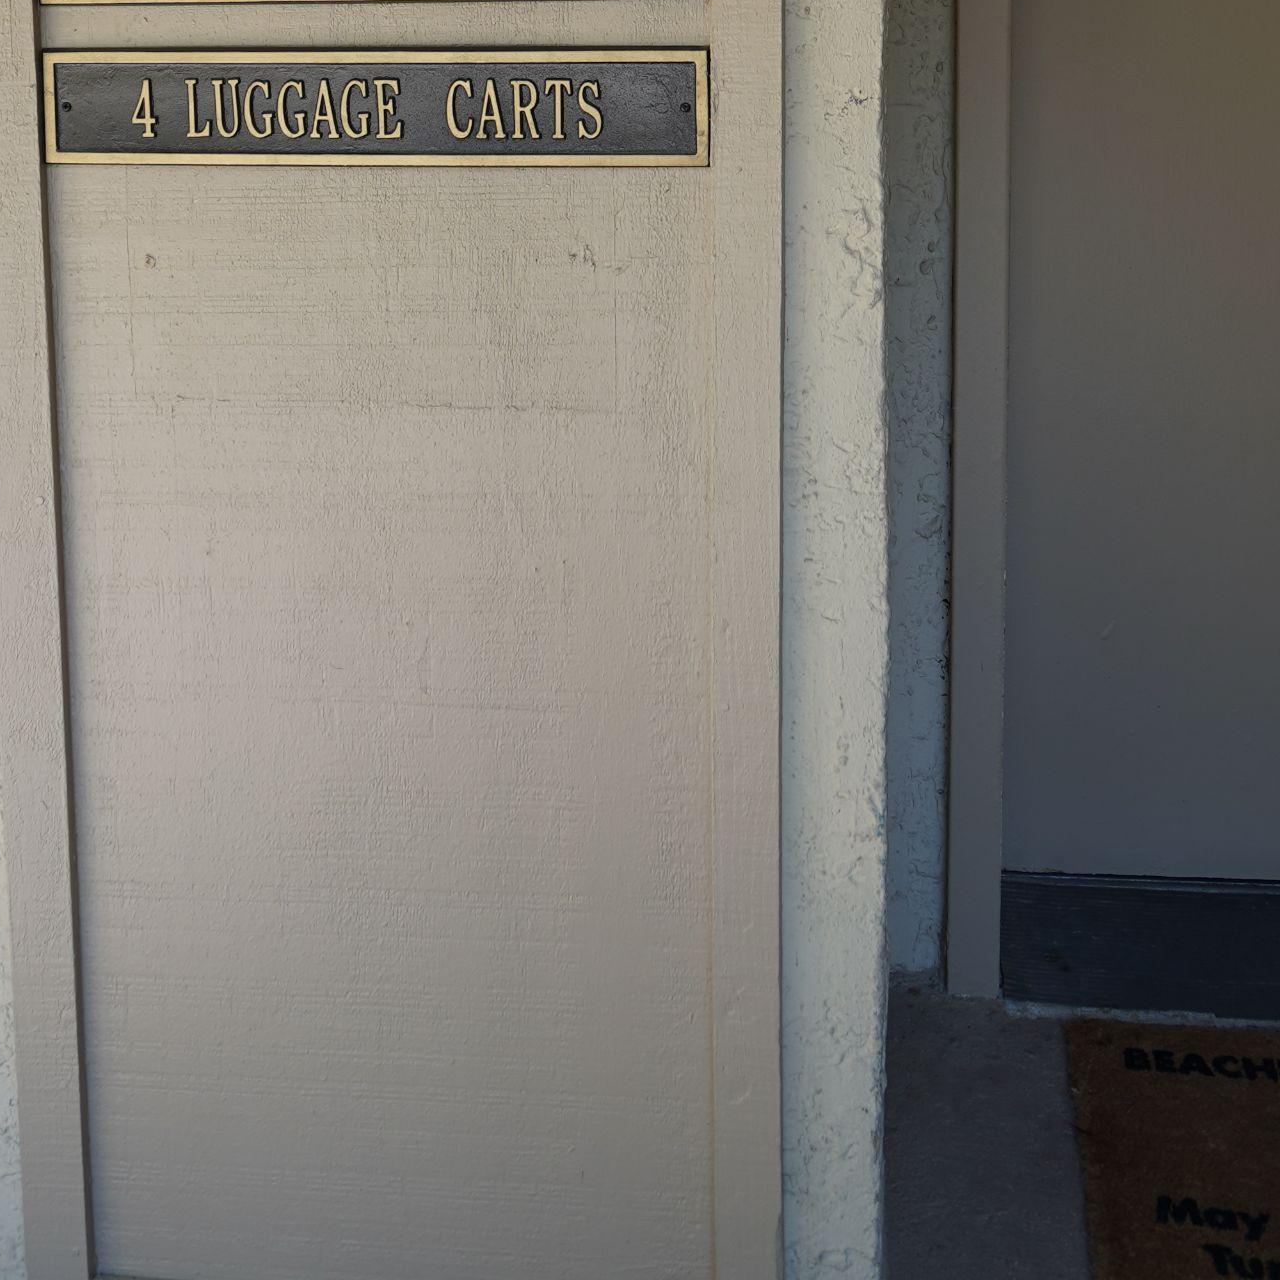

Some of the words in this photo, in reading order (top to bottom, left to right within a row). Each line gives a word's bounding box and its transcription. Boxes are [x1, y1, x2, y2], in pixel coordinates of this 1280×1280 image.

[131, 78, 156, 139] 4
[186, 77, 403, 140] LUGGAGE
[445, 78, 604, 140] CARTS
[1155, 1194, 1270, 1241] May
